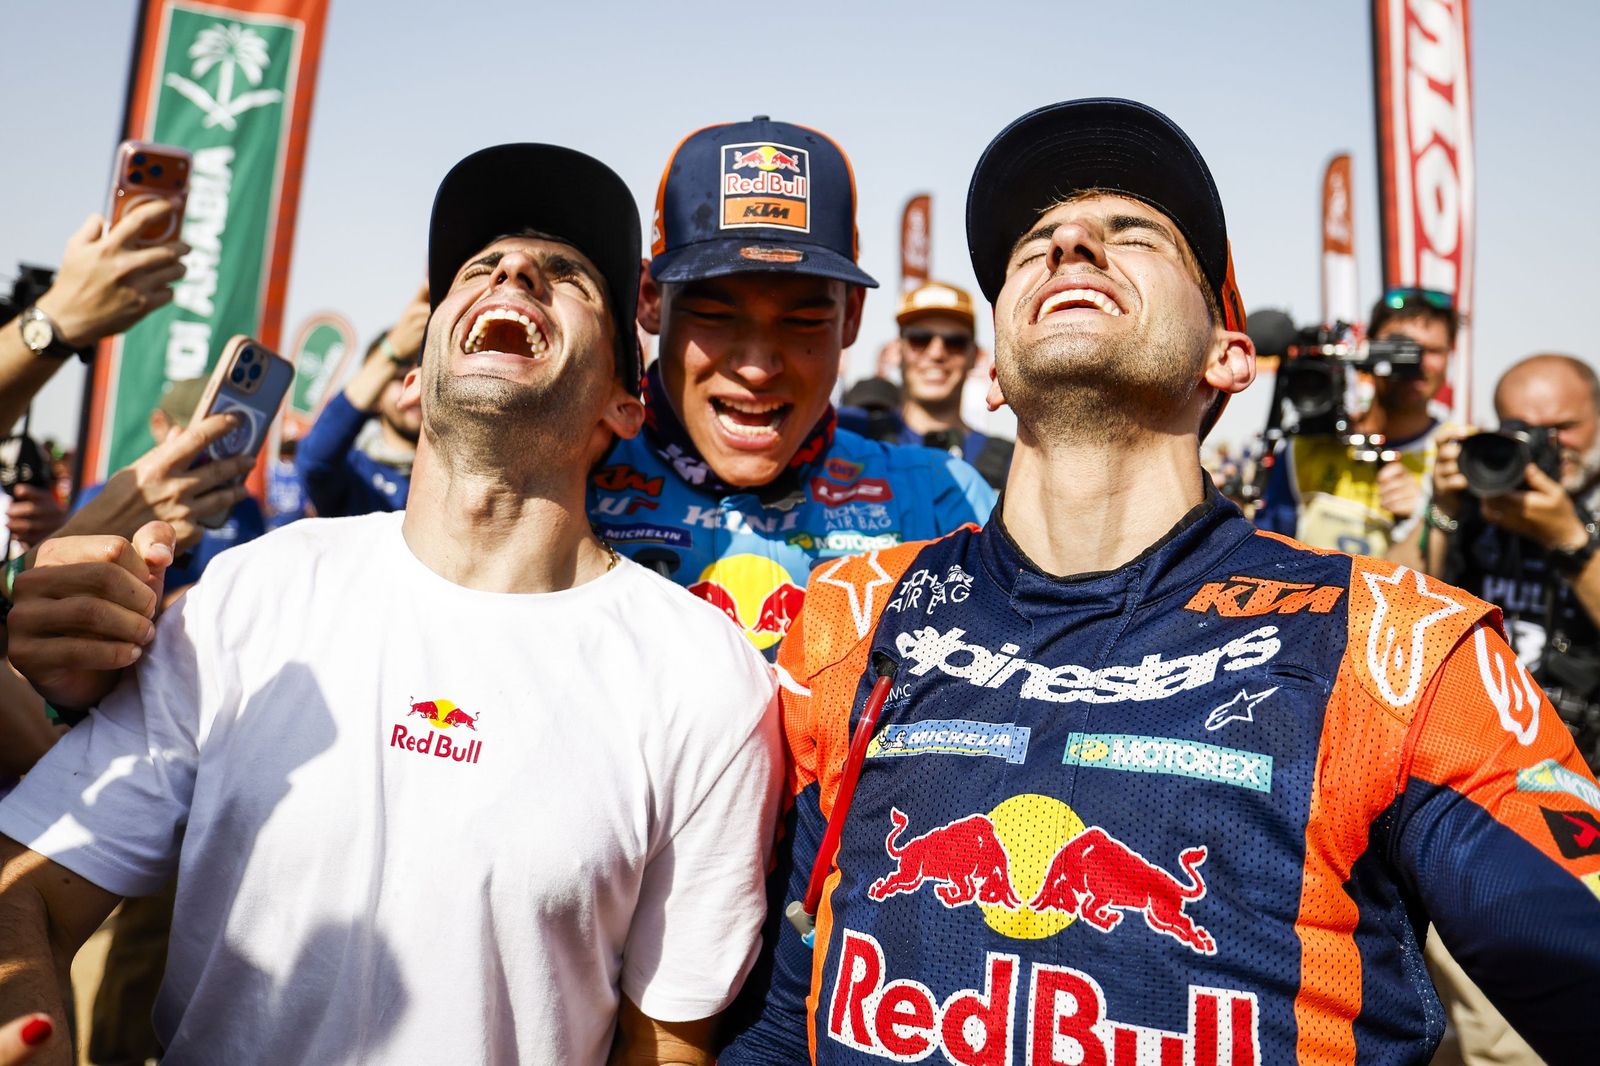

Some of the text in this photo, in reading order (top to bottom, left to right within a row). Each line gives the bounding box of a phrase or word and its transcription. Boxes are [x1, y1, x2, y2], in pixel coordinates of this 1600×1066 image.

[725, 171, 807, 198] Red Bull
[743, 202, 790, 219] KTM
[605, 529, 682, 541] MICHELIN
[826, 515, 892, 531] AIR BAG
[815, 533, 899, 550] MOTOREX
[1183, 575, 1345, 617] KTM
[895, 625, 1282, 704] alpinestars
[390, 724, 482, 764] Red Bull
[908, 730, 1012, 747] MICHELIN
[1111, 739, 1261, 784] MOTOREX
[827, 928, 1262, 1066] Red Bull
